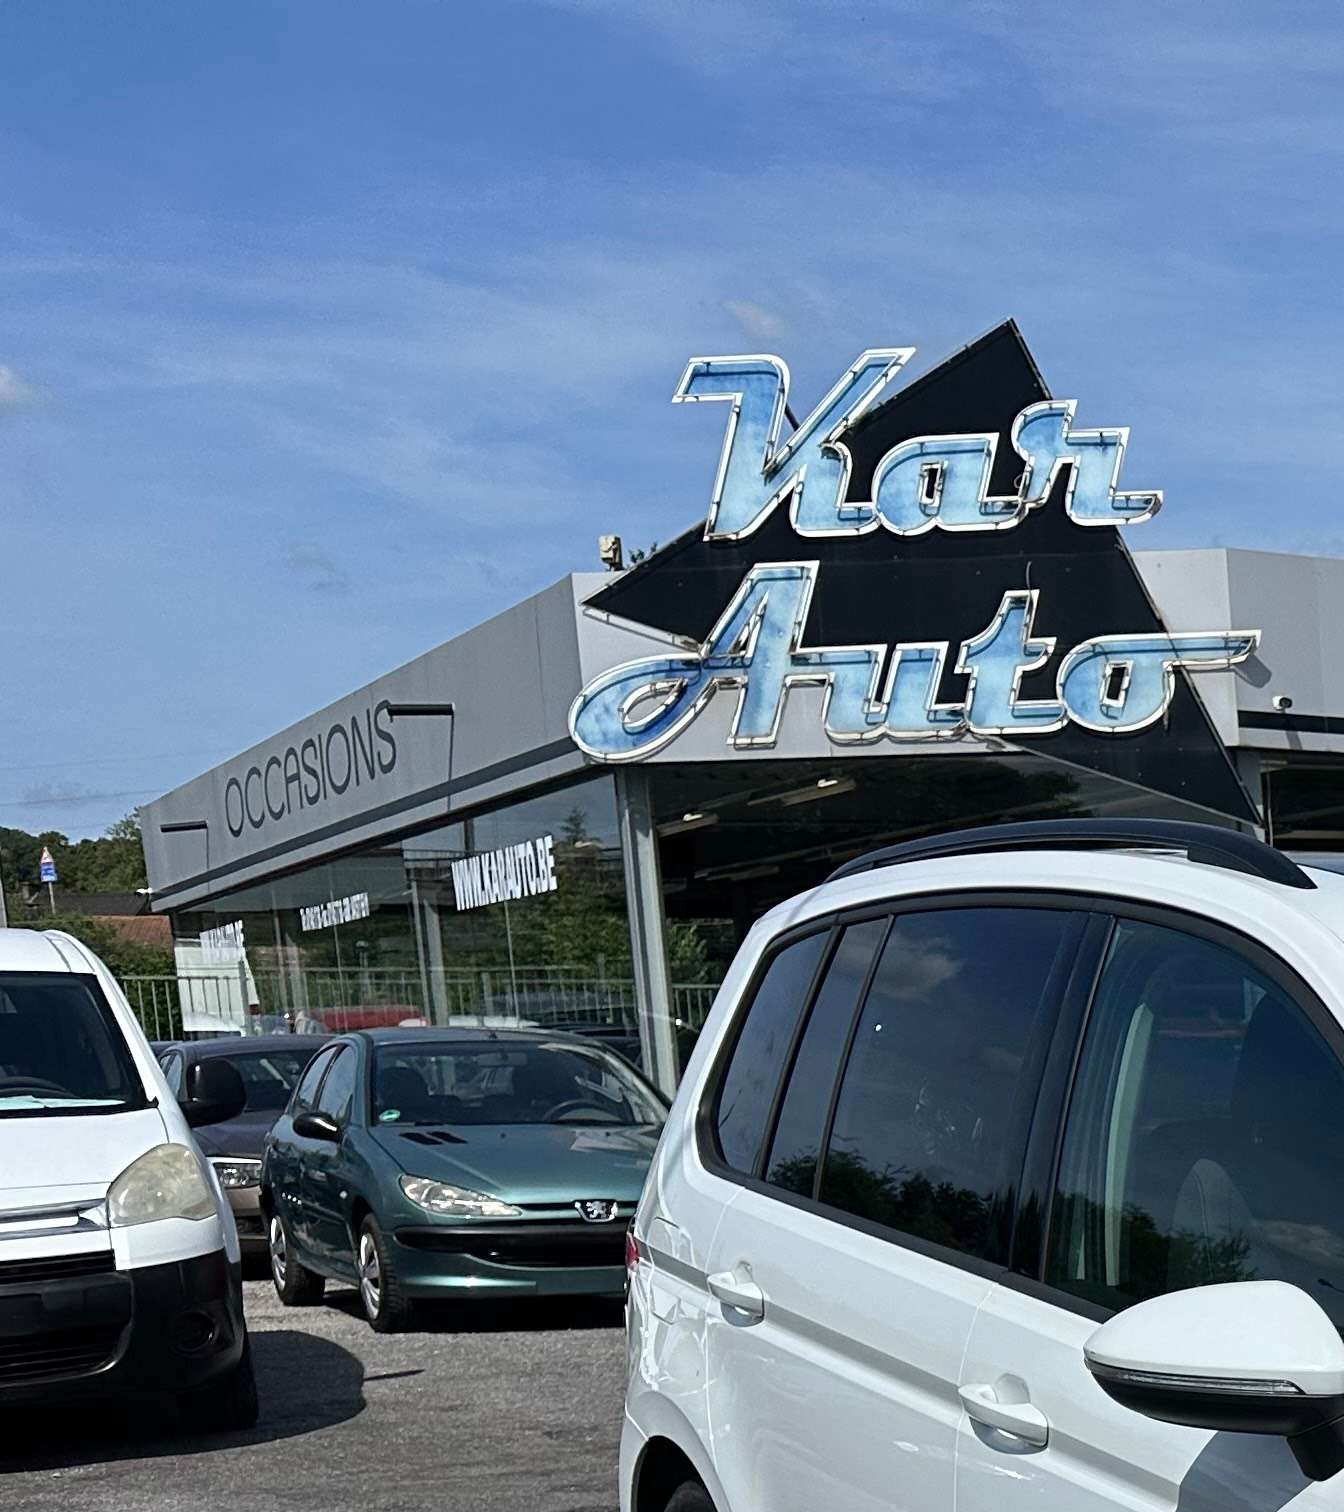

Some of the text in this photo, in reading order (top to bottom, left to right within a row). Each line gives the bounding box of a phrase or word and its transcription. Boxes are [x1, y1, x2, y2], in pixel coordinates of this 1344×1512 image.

[672, 347, 1164, 543] Kar
[568, 560, 1262, 764] Auto
[224, 699, 397, 838] OCCASIONS
[450, 834, 558, 912] WWW.KARAUTO.BE
